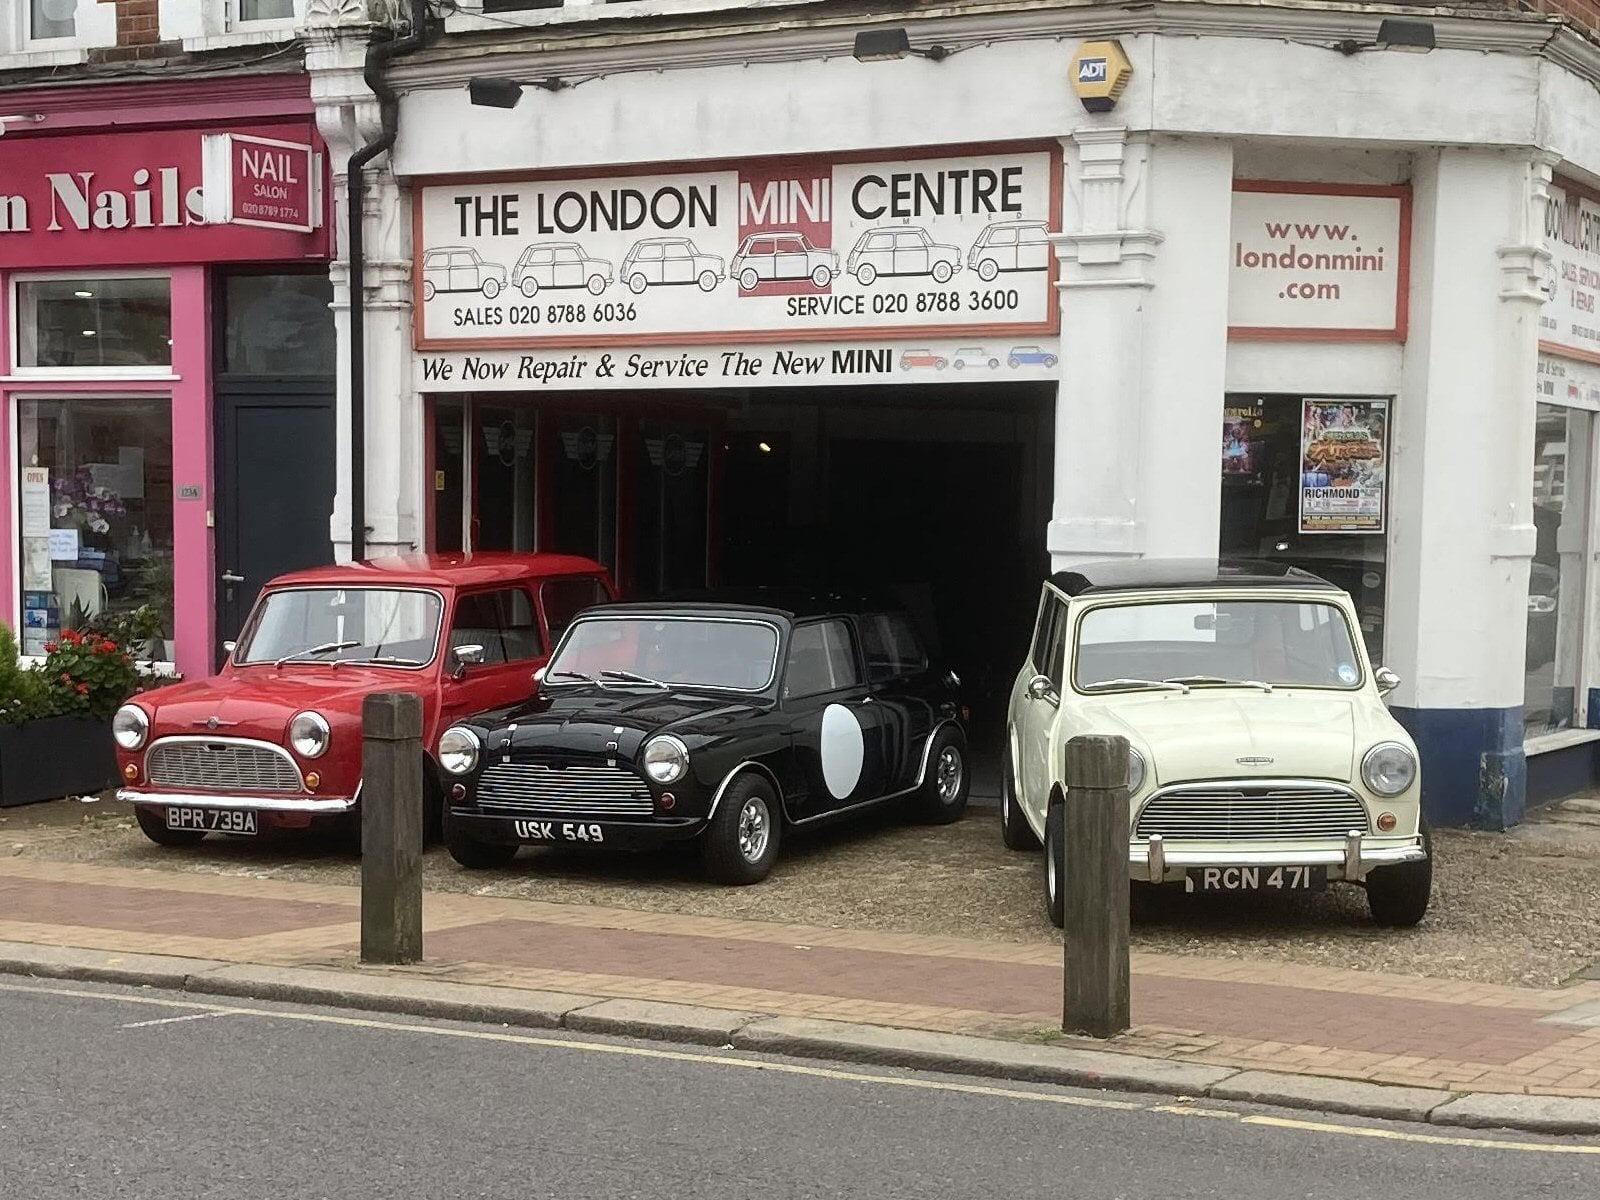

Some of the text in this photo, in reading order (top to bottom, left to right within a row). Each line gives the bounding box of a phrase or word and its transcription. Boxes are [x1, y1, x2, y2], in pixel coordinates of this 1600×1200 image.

[1080, 62, 1106, 78] ADT
[242, 148, 298, 184] NAIL
[44, 167, 205, 231] Nails
[253, 183, 288, 199] SALON
[454, 166, 1023, 237] THE LONDON MINI CENTRE
[242, 202, 258, 214] 020
[279, 207, 299, 219] 1774
[1265, 223, 1358, 241] www.
[1235, 243, 1384, 271] londonmini
[1278, 282, 1341, 300] .com
[453, 302, 638, 327] SALES 020 8788 6036
[786, 289, 1019, 317] SERVICE 020 8788 3600
[422, 348, 893, 384] We Now Repair & Service The New MINI
[1304, 488, 1360, 499] RICHMOND
[169, 808, 255, 830] BPR 739A
[514, 819, 604, 842] USK 549
[1203, 866, 1311, 889] RCN 471
